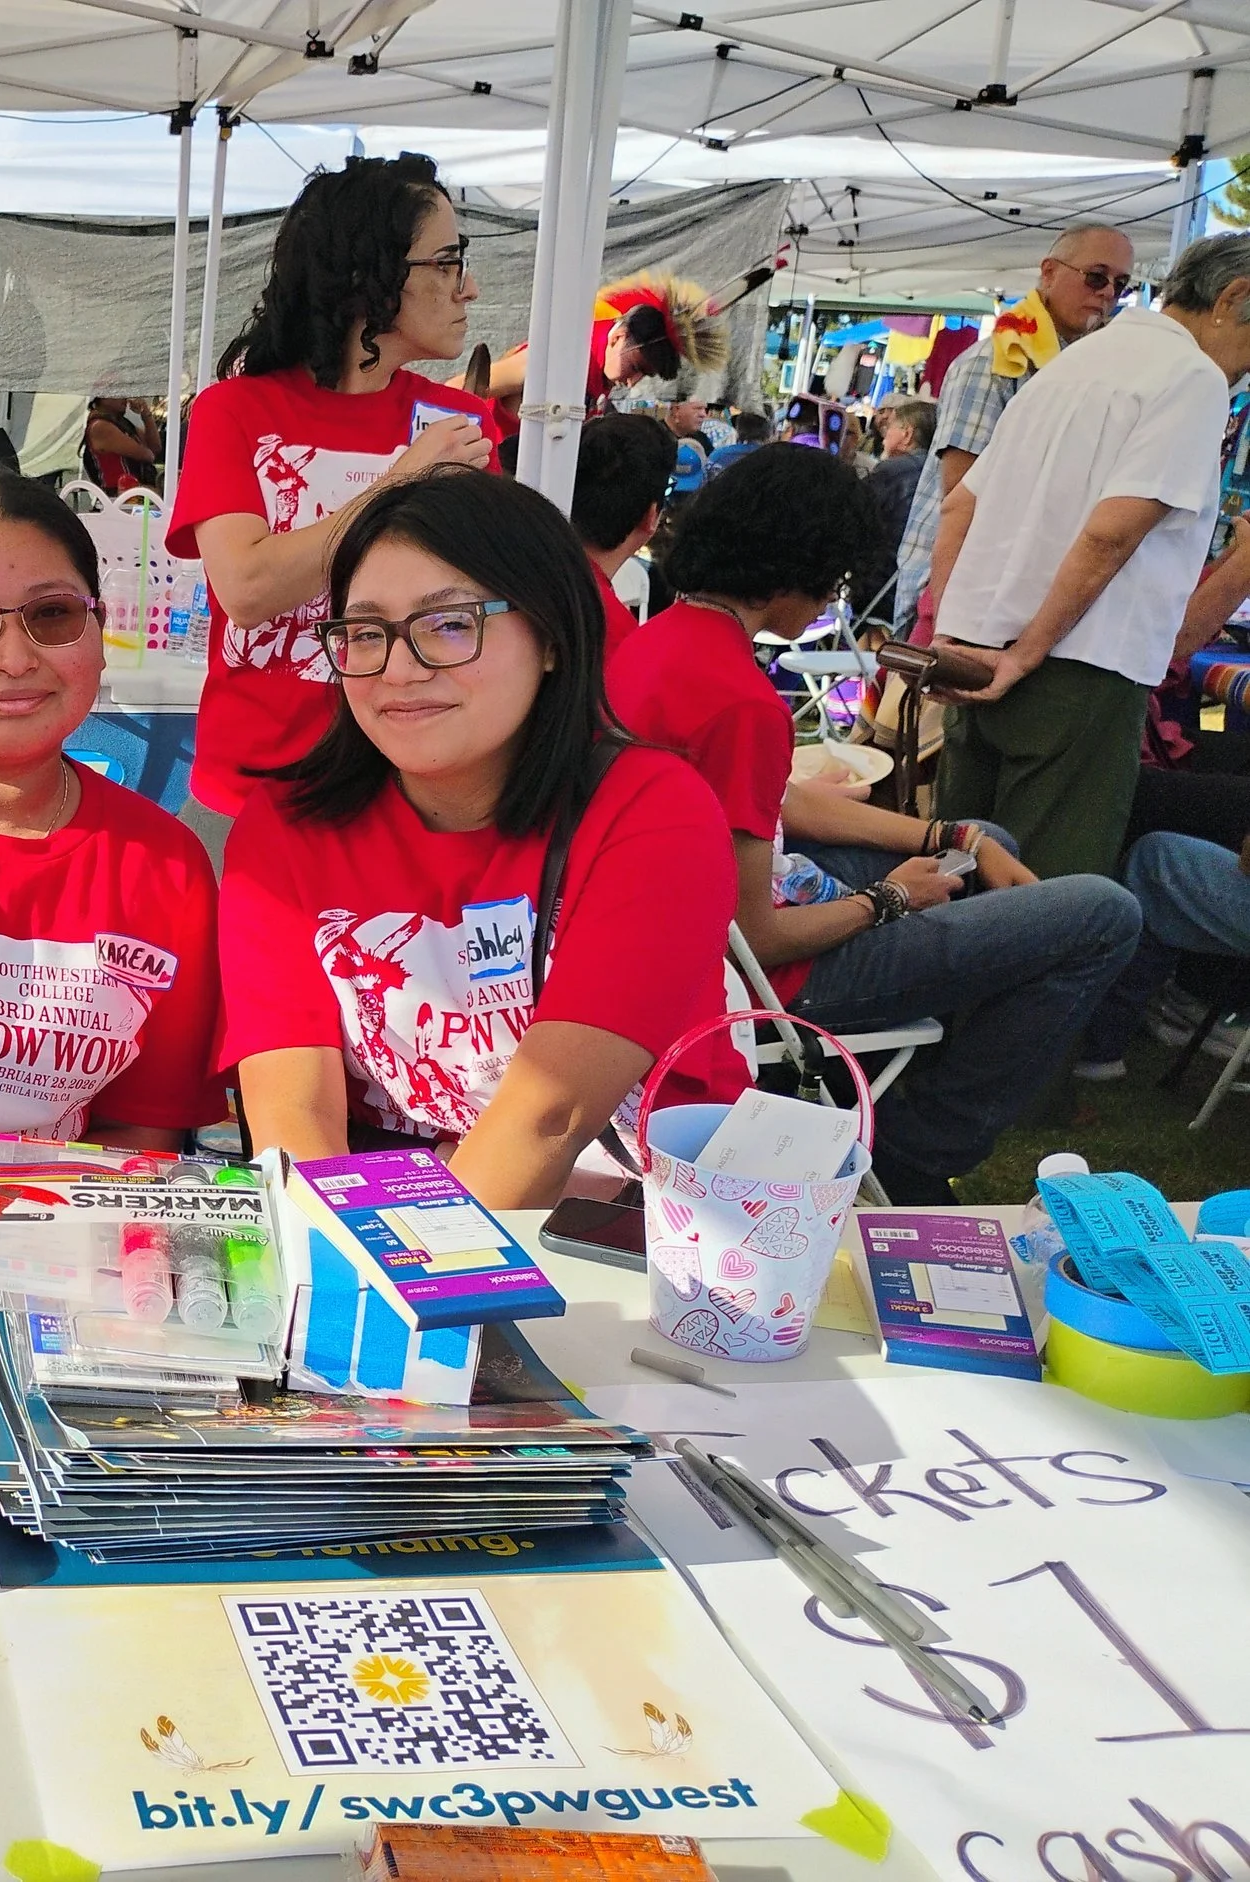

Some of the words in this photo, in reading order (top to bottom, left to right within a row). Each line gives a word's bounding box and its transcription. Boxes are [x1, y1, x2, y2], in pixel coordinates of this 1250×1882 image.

[465, 922, 525, 966] shley
[97, 937, 165, 975] KAREN
[19, 982, 94, 1004] COLLEGE
[477, 977, 531, 1006] ANNU
[38, 1006, 112, 1032] ANNUAL
[53, 1030, 133, 1076] WOW
[0, 1083, 31, 1098] CHULA
[184, 1155, 223, 1164] CLASSIC
[382, 1178, 456, 1194] Salesbook
[397, 1191, 430, 1200] Purpose
[431, 1188, 462, 1198] General
[72, 1193, 263, 1213] MARKERS
[131, 1208, 194, 1222] Project
[203, 1212, 264, 1225] Jumbo
[1085, 1207, 1113, 1240] TICKET
[1137, 1202, 1164, 1237] COUPON
[1138, 1219, 1158, 1243] KEEP
[389, 1256, 421, 1266] PACK!
[931, 1243, 1005, 1259] Salesbook
[489, 1272, 540, 1284] Salesbook
[1156, 1257, 1190, 1290] TICKET
[1215, 1269, 1238, 1292] KEEP
[978, 1337, 1030, 1350] Salesbook
[1196, 1312, 1226, 1356] TICKET
[643, 1429, 1168, 1531] Tckets
